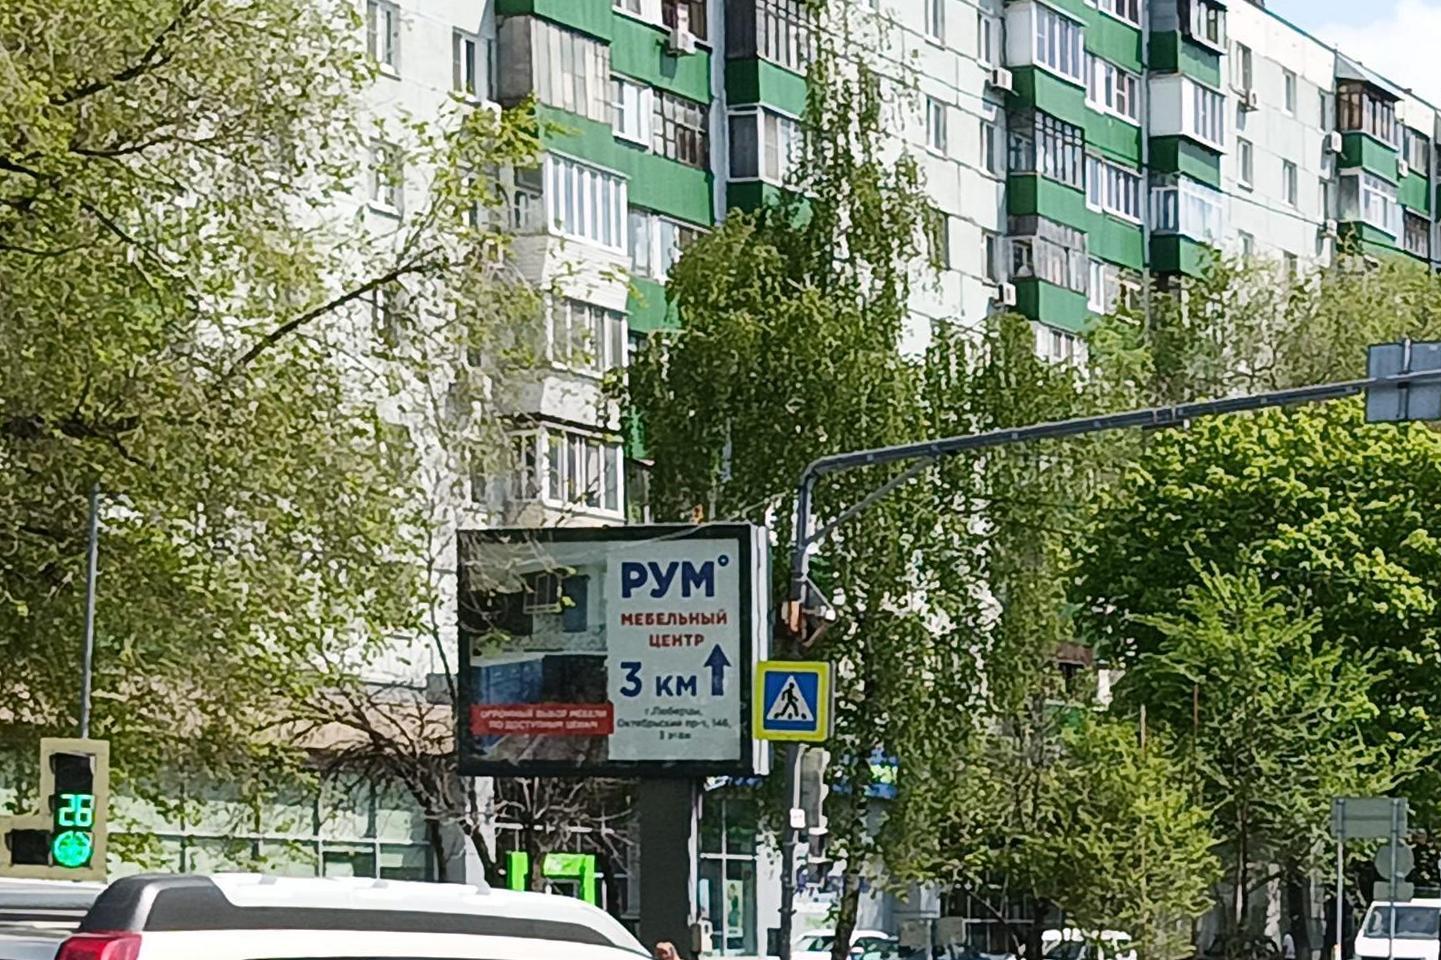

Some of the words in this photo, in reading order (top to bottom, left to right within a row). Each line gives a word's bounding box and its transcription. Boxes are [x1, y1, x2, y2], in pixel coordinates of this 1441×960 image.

[621, 608, 727, 626] МЕБЕЛЬНЫЙ
[649, 633, 705, 648] ЦЕНТР
[620, 661, 642, 697] 3
[58, 793, 95, 827] 26
